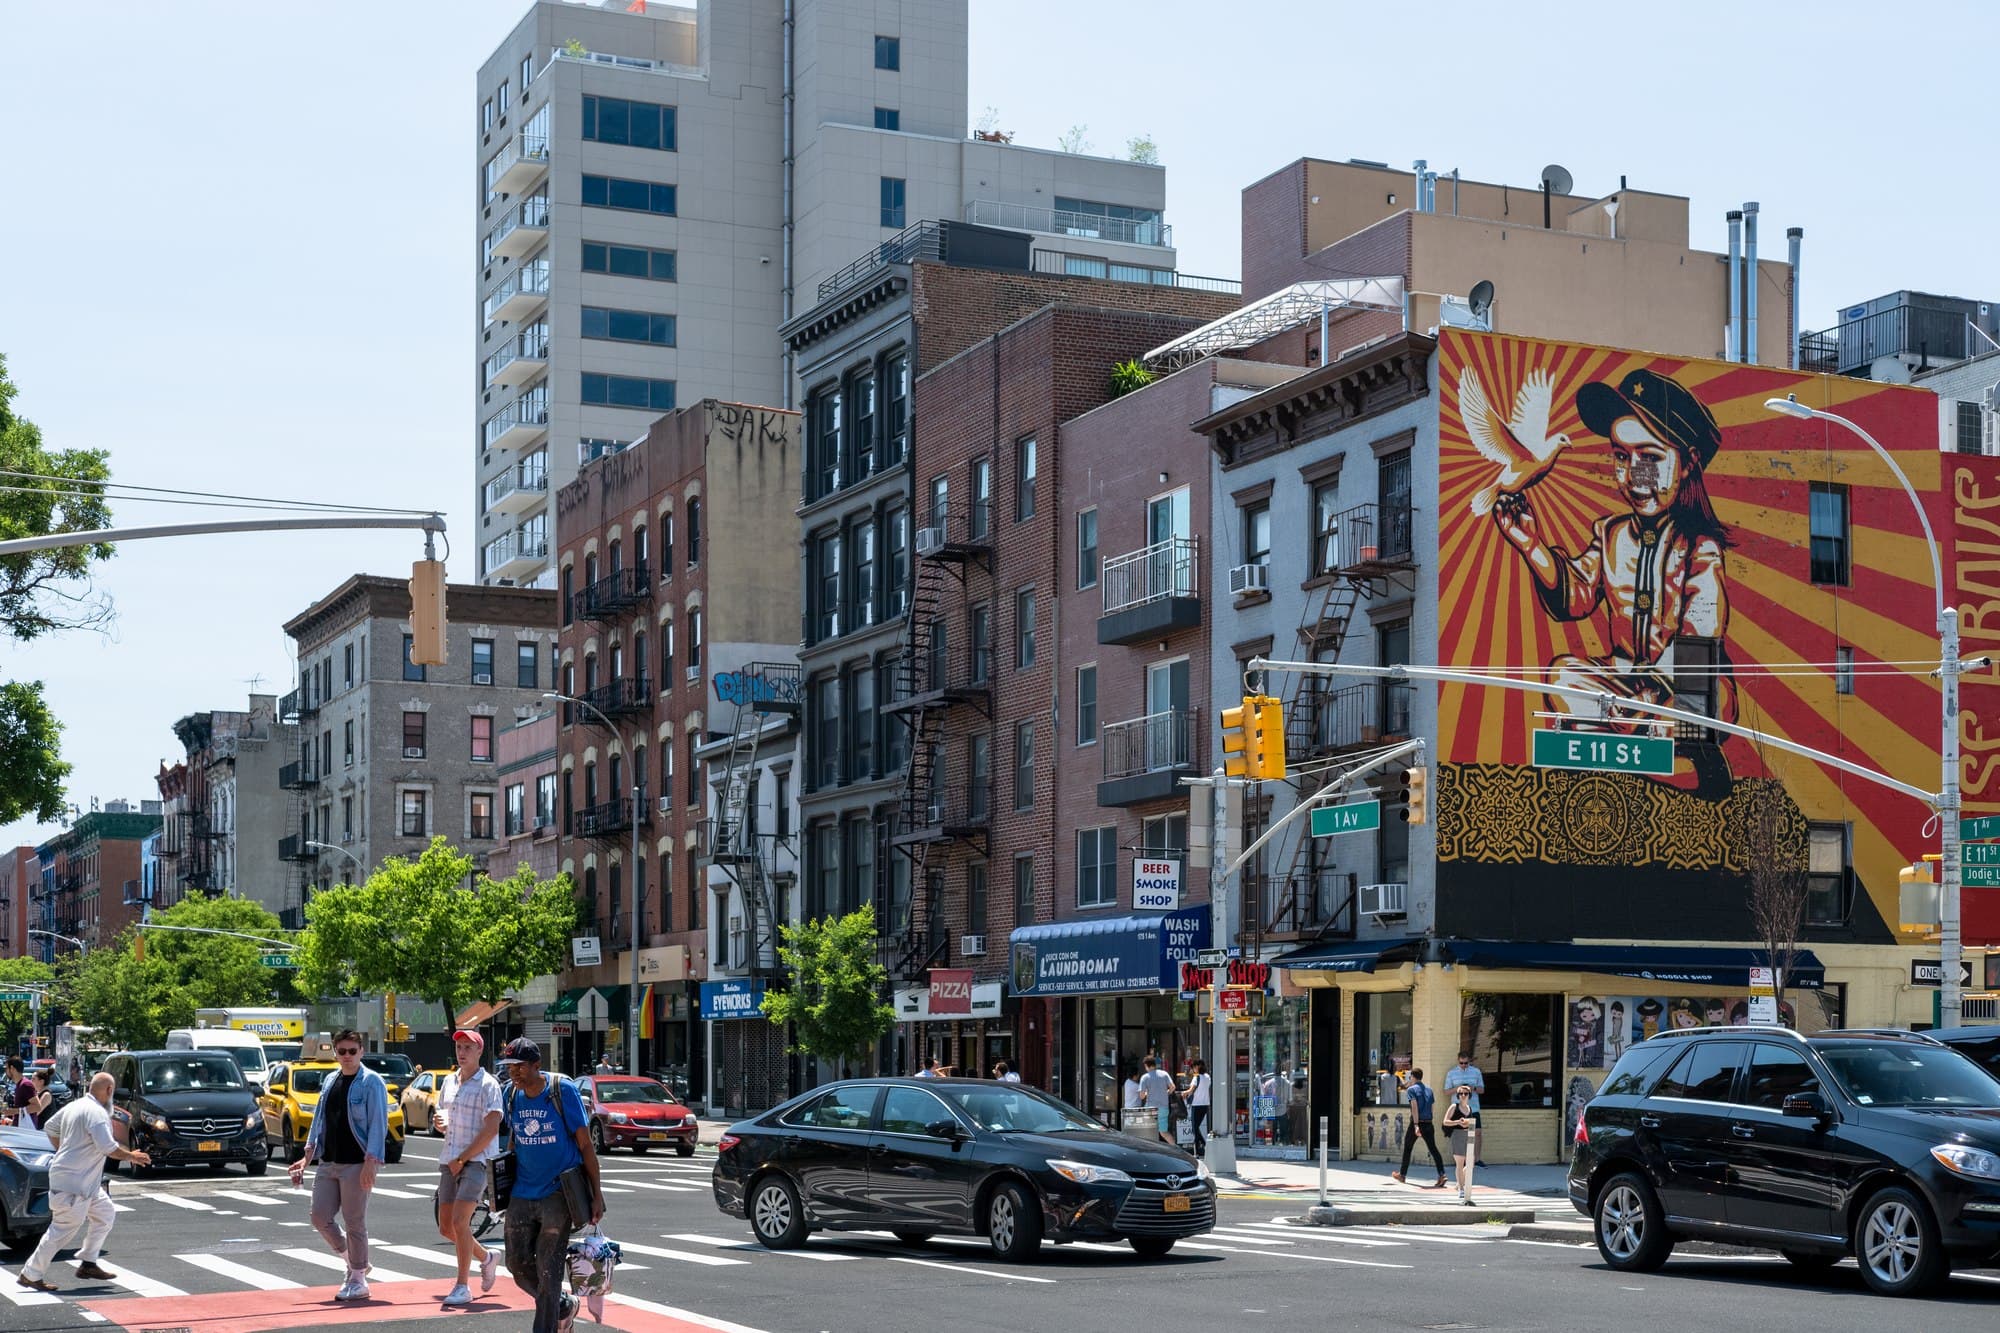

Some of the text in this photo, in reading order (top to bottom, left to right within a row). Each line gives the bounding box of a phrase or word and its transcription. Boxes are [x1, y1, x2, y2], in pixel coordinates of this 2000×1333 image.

[1568, 740, 1641, 765] E 11 St
[1334, 811, 1358, 828] 1 Av
[1973, 819, 1990, 837] 1 Av
[1966, 845, 1997, 862] E 11 St
[1142, 863, 1171, 874] BEER
[1968, 868, 1992, 880] Jodie
[1136, 879, 1177, 890] SMOKE
[1140, 895, 1172, 906] SHOP
[1164, 918, 1199, 931] WASH
[1169, 933, 1193, 946] DRY
[1166, 947, 1197, 960] FOLD
[263, 957, 269, 965] E
[271, 957, 282, 965] 10
[1040, 957, 1120, 978] LAUNDROMAT
[1182, 958, 1270, 991] SMO SHOP
[1920, 967, 1938, 978] ONE
[1110, 978, 1125, 988] CLEAN
[930, 982, 970, 999] PIZZA
[713, 993, 751, 1011] EYEWORKS
[243, 1022, 277, 1033] super
[552, 1026, 571, 1035] ATM
[1258, 1097, 1273, 1108] BUD
